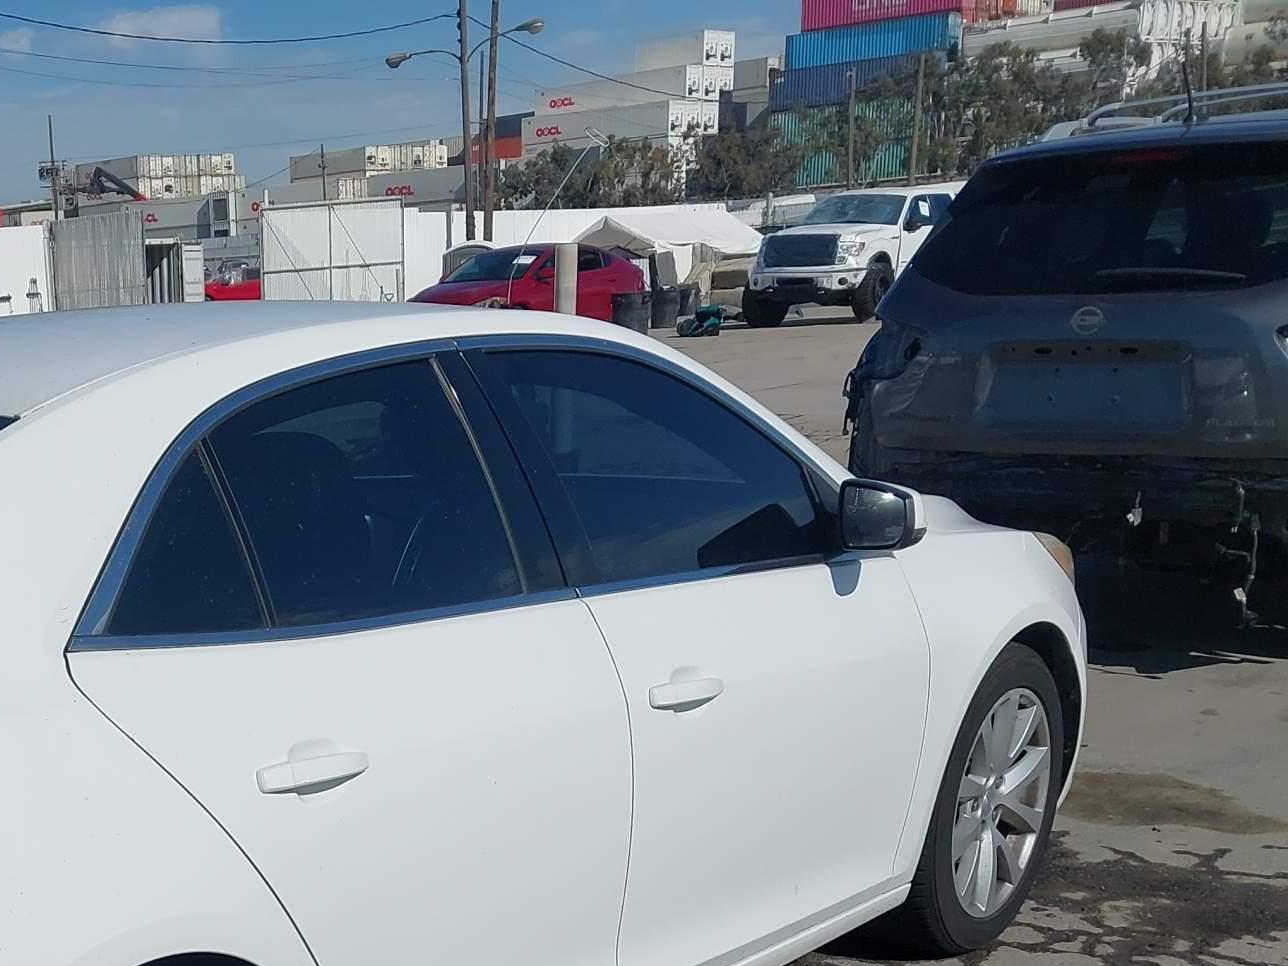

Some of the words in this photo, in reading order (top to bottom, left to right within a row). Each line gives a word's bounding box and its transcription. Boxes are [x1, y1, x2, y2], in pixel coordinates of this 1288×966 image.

[549, 97, 575, 109] OOCL
[535, 125, 562, 137] OOCL
[385, 184, 415, 197] OOCL
[144, 212, 159, 223] CL
